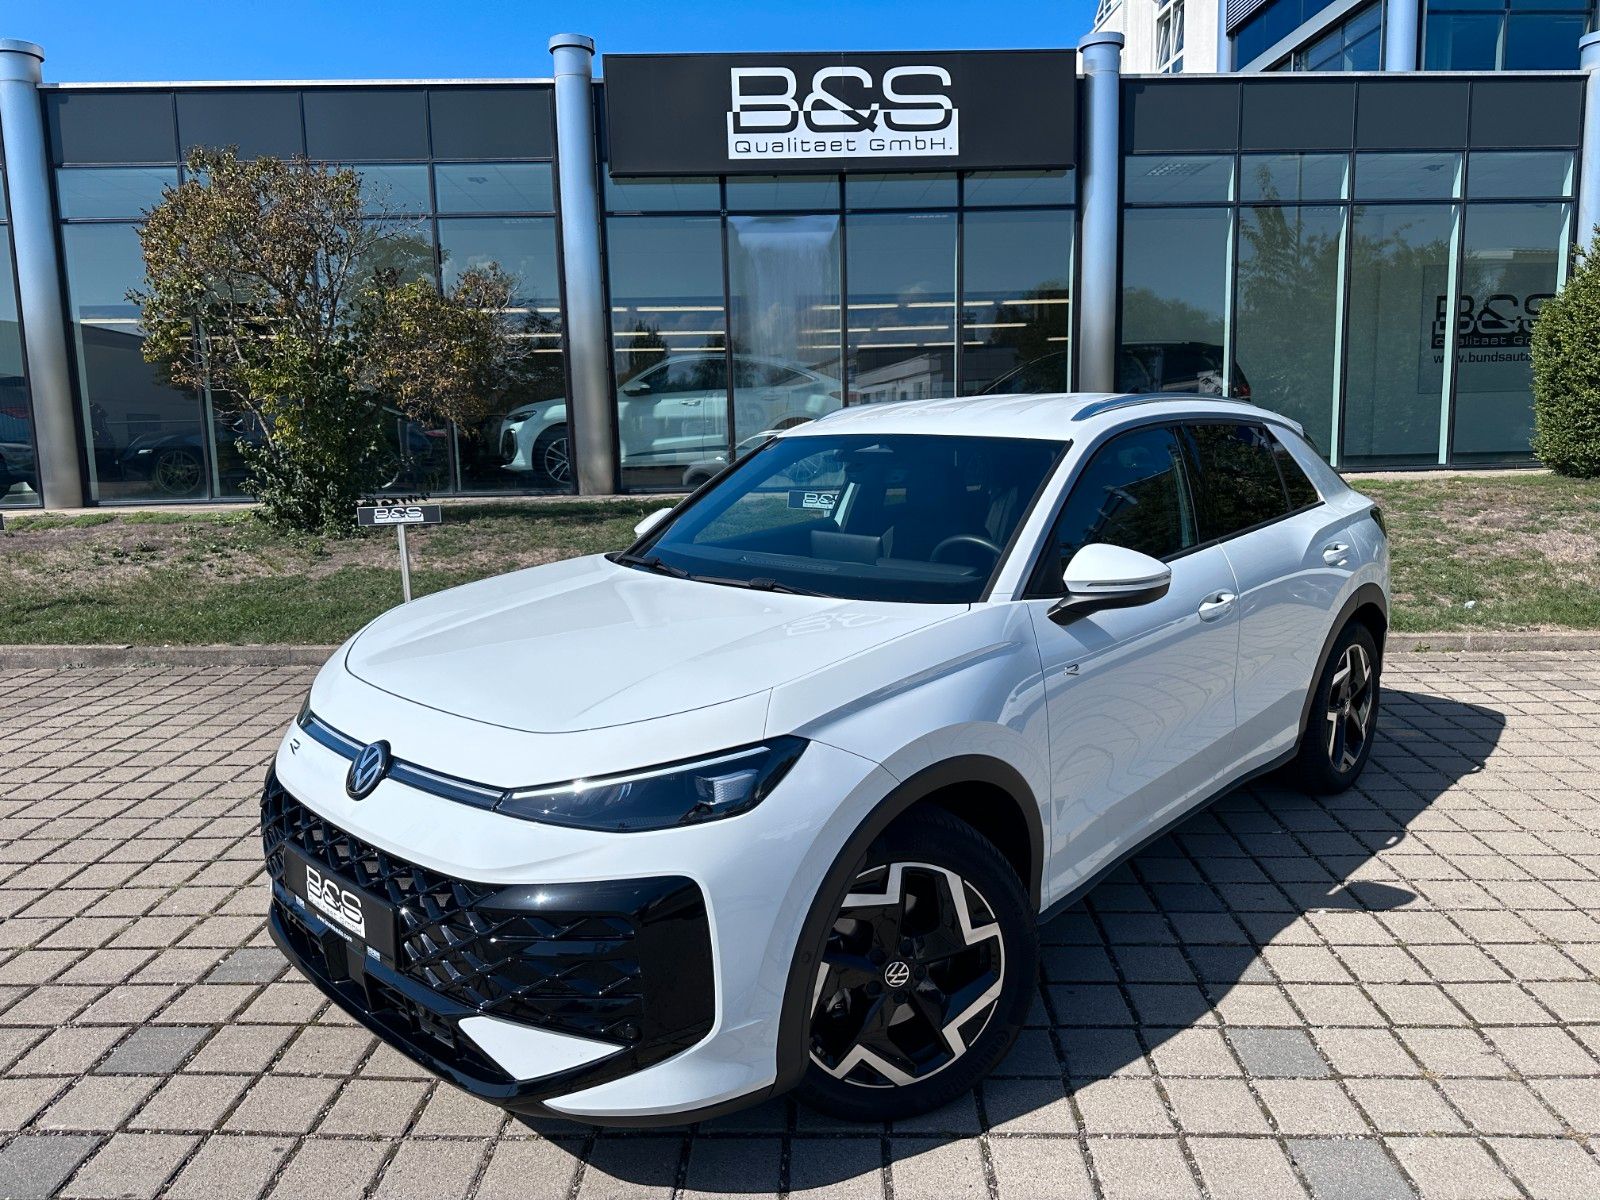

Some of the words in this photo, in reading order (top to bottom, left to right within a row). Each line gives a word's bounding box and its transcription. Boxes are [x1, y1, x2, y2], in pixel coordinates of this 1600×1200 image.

[731, 65, 953, 134] B&S
[735, 137, 857, 153] Qualitaet
[869, 136, 953, 151] GmbH.
[1434, 335, 1507, 346] Qalitaet
[804, 493, 838, 504] B&
[374, 506, 422, 520] B&S
[305, 864, 363, 925] B&S
